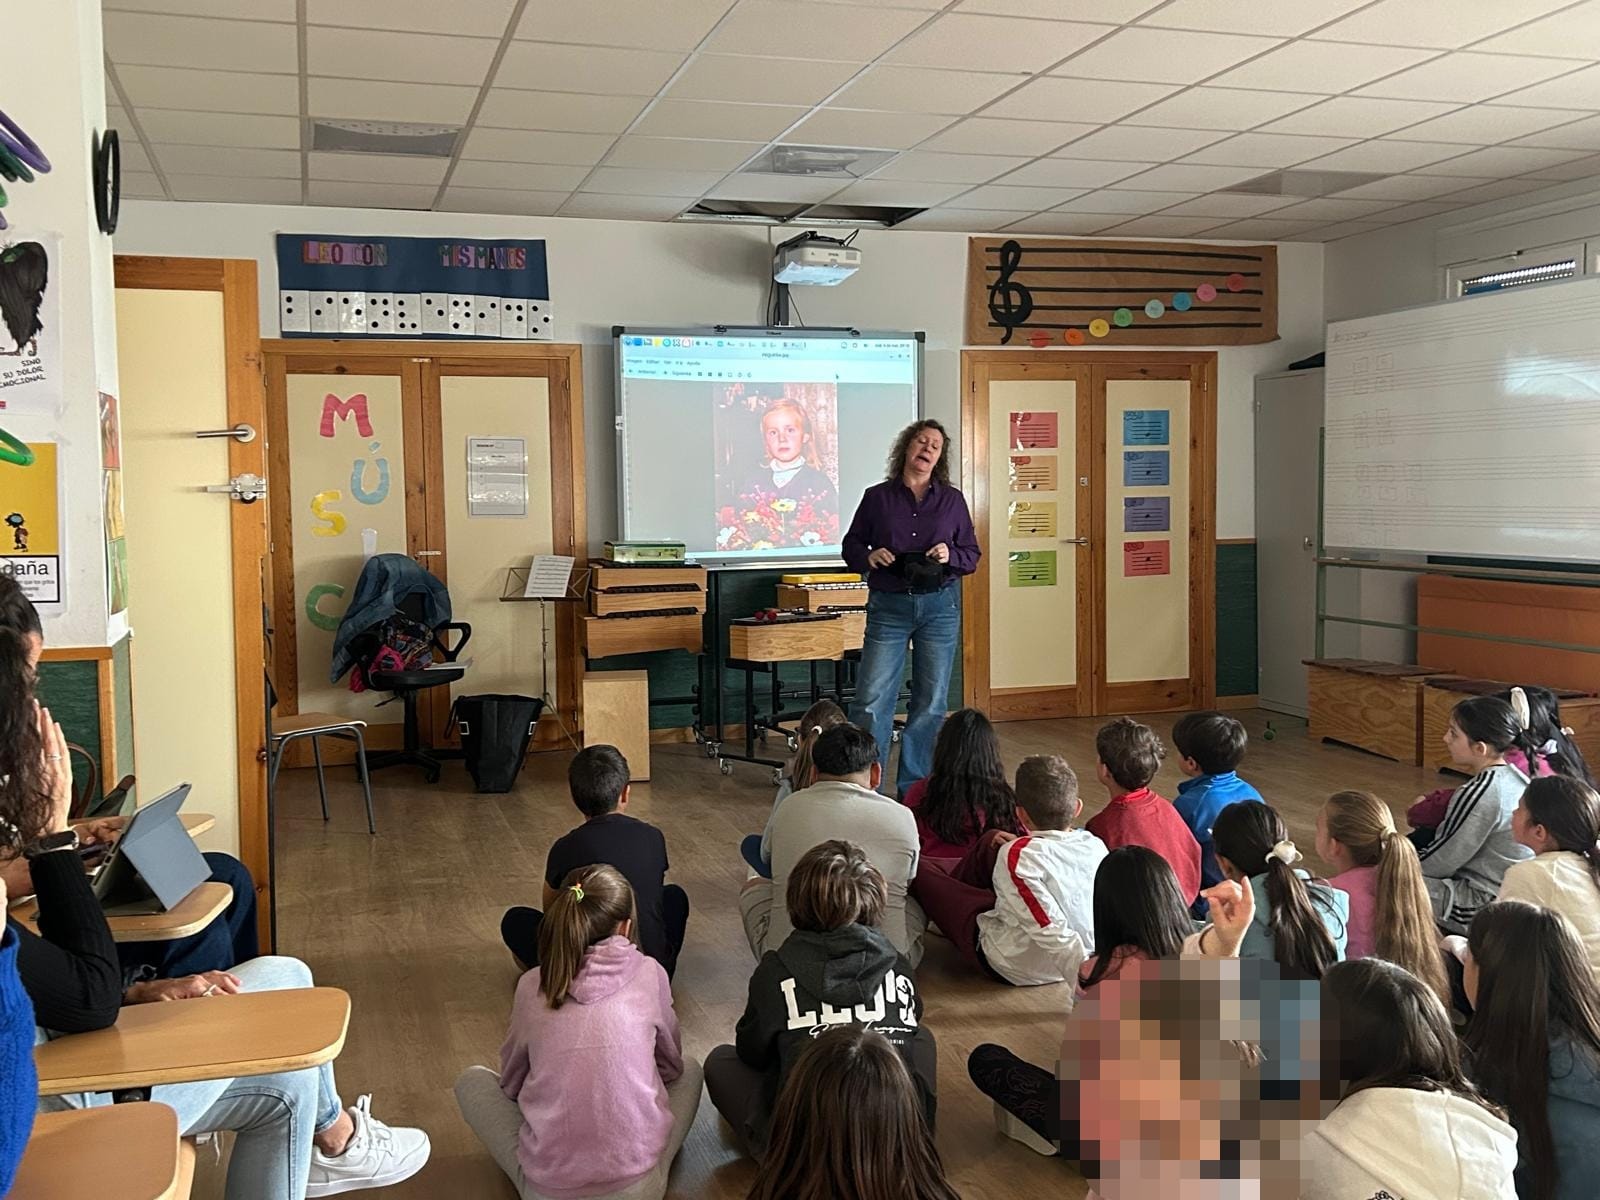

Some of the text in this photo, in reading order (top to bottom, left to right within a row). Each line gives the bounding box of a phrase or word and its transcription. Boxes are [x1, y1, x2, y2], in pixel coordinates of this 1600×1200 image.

[304, 240, 343, 264] LEO
[440, 245, 475, 268] MIS
[475, 247, 527, 270] MANOS
[21, 357, 41, 367] SINO
[3, 366, 44, 379] SU DOLOR
